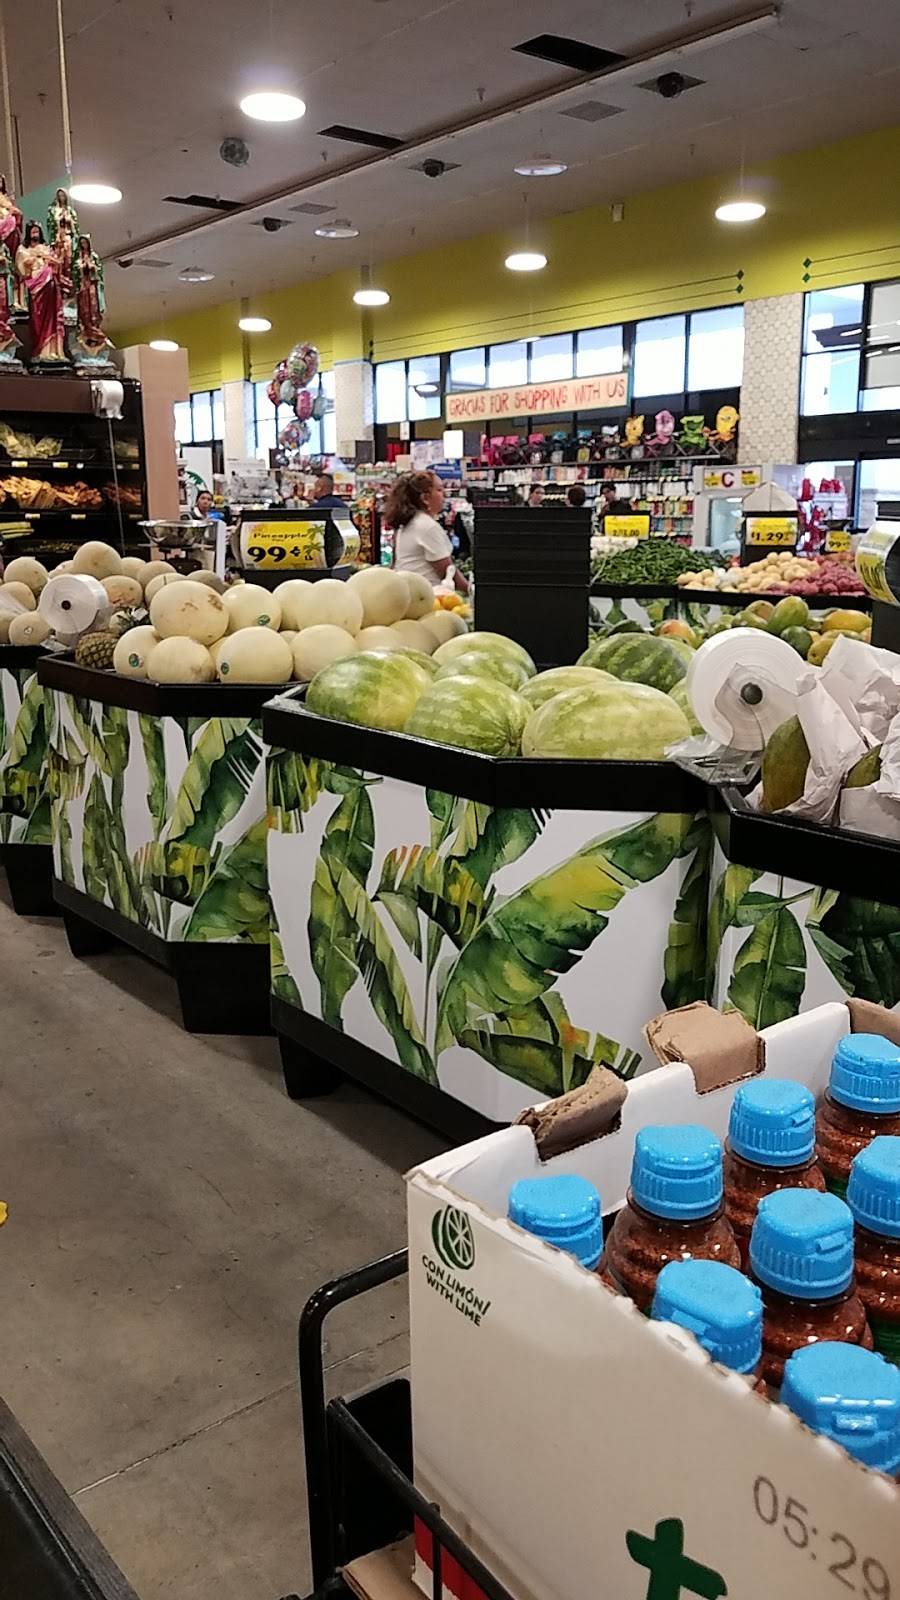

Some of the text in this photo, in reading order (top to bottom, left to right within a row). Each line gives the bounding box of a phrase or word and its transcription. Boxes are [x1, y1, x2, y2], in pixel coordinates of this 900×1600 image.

[449, 378, 625, 416] GRACIAS FOR SHOPPING WITH US
[721, 471, 735, 488] C
[422, 1254, 445, 1281] CON
[426, 1271, 482, 1327] WITH LIME
[753, 1475, 891, 1600] 05:29
